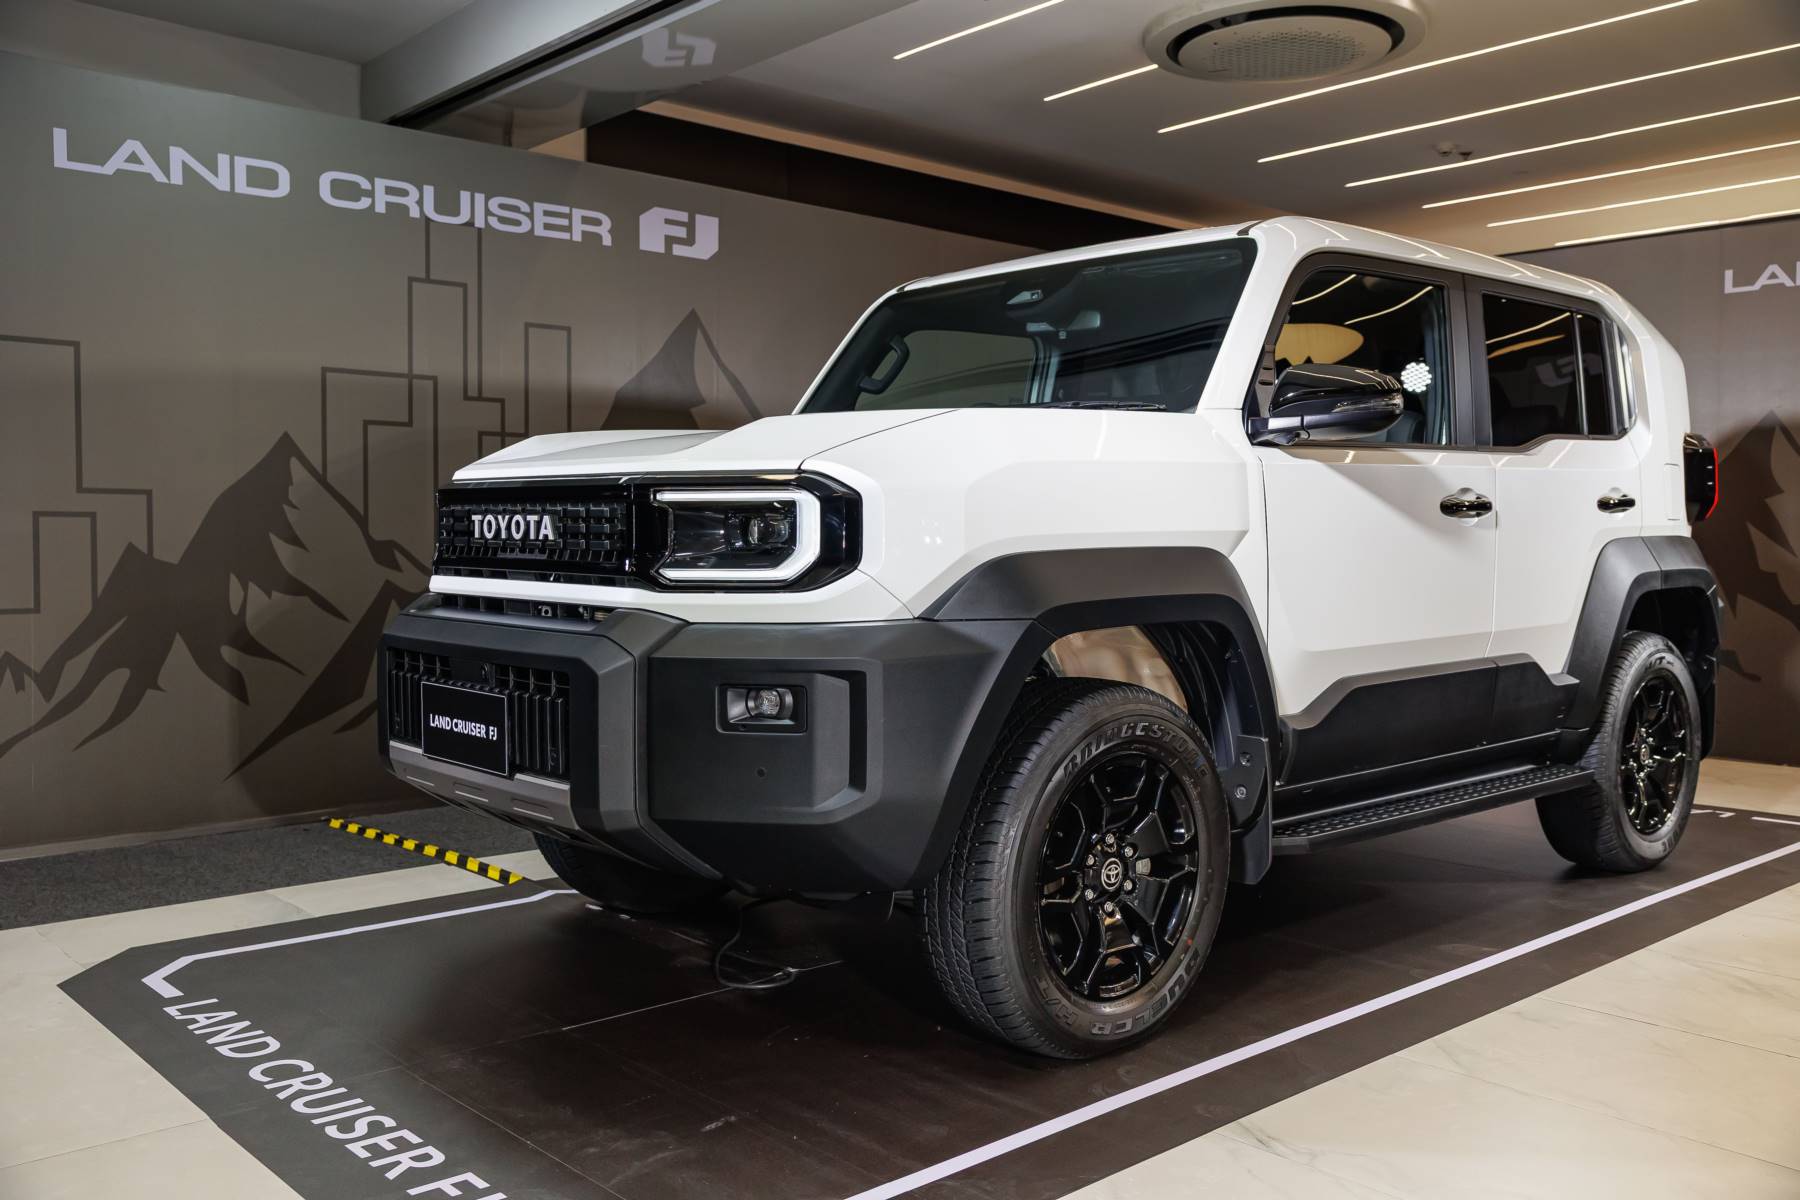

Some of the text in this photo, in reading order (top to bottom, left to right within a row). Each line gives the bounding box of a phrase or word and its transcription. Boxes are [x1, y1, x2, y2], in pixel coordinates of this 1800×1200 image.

[53, 127, 719, 260] LAND CRUISER FJ
[1724, 261, 1800, 294] LA
[471, 514, 555, 540] TOYOTA
[429, 713, 498, 741] LAND CRUISER FJ
[162, 998, 508, 1200] LAND CRUISER F
